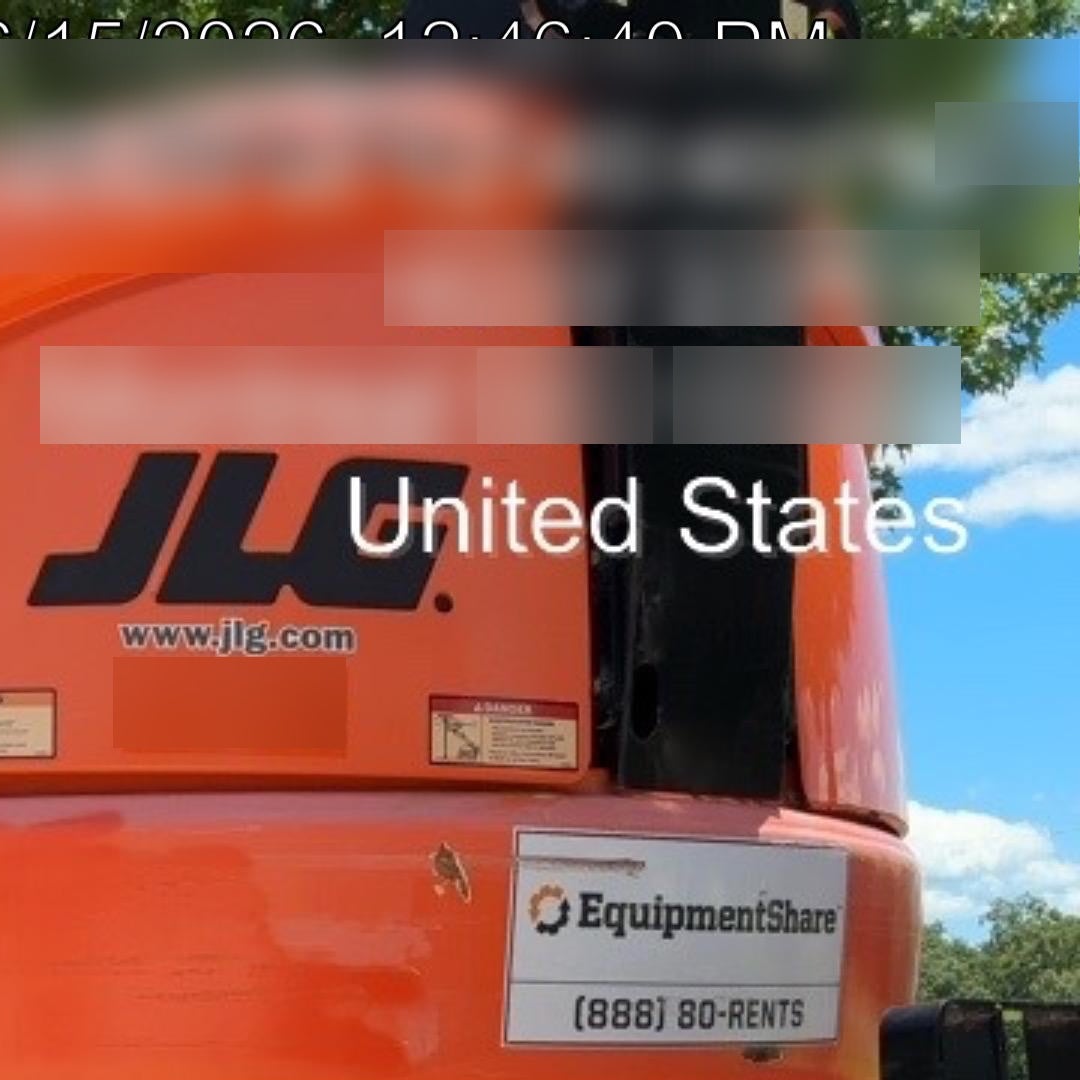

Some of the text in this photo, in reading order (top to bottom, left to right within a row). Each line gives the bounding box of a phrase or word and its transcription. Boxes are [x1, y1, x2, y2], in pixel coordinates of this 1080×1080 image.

[28, 452, 470, 612] JLG
[121, 619, 356, 655] www.jlg.com
[578, 891, 836, 938] EquipmentShare
[574, 996, 805, 1032] (888) 80-RENTS
